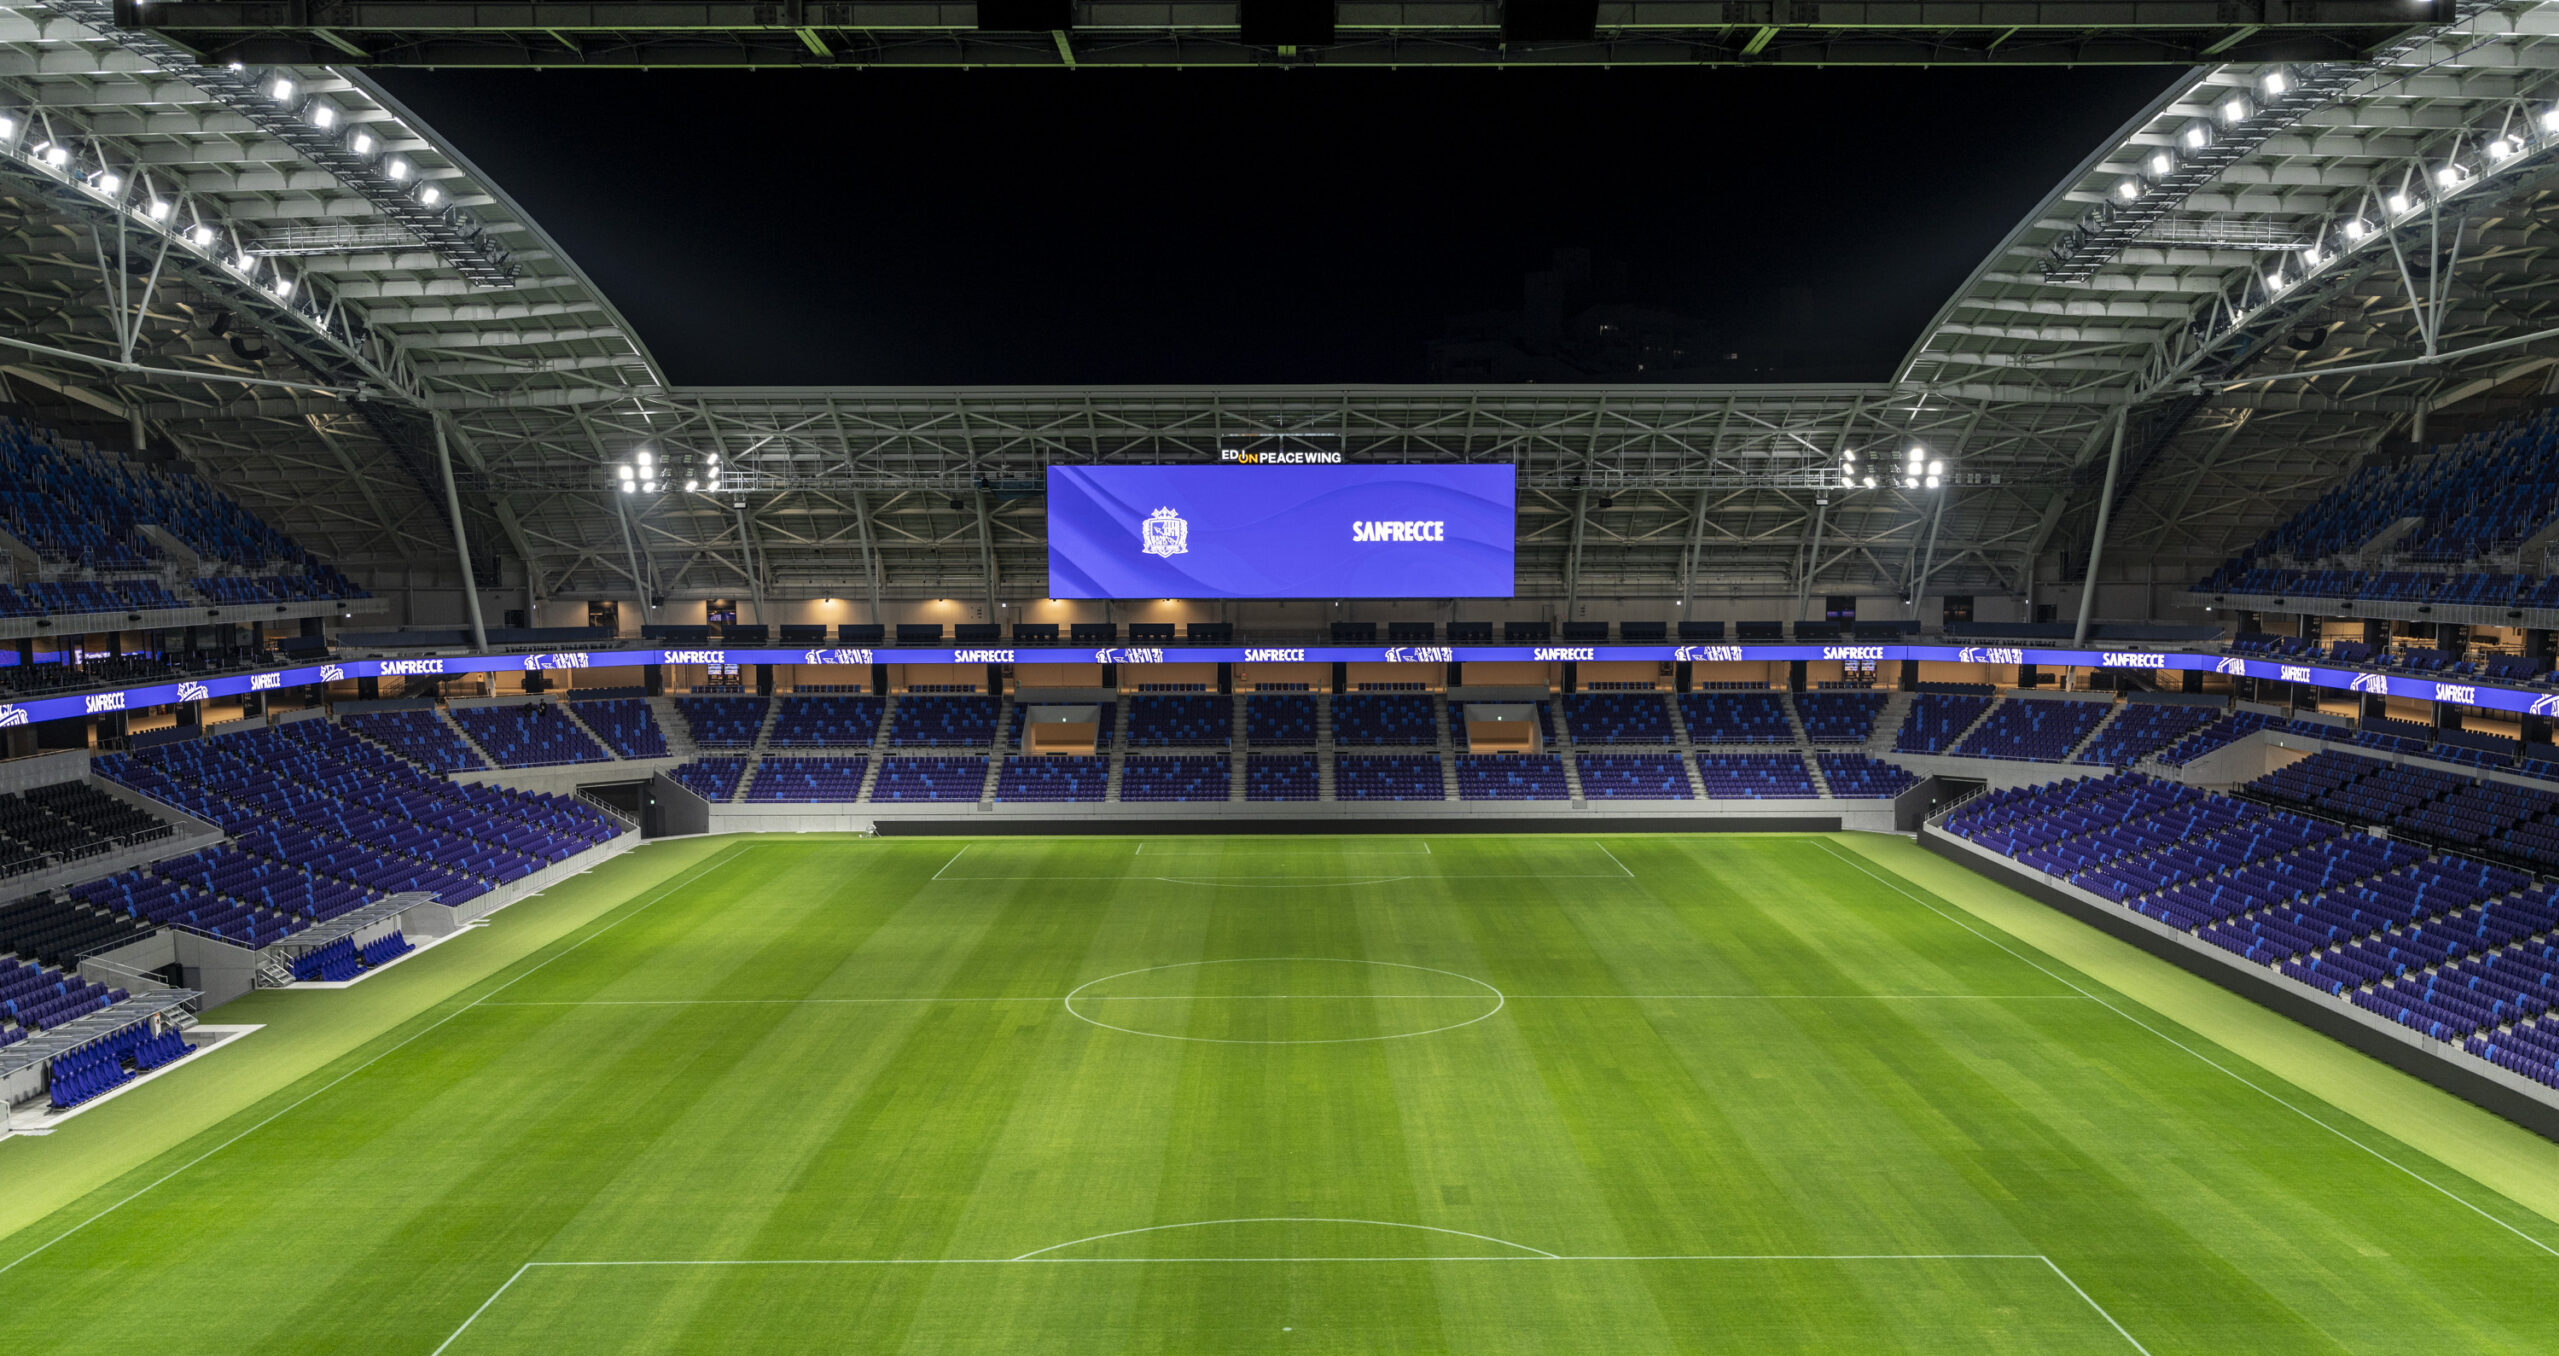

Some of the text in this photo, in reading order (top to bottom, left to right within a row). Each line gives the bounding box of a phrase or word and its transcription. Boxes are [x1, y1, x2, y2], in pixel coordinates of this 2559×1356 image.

[1221, 449, 1342, 463] EDION PEACE WING
[1352, 520, 1444, 542] SANFRECCE
[664, 650, 725, 664] SANFRECCE
[954, 649, 1015, 663] SANFRECCE
[1244, 648, 1305, 662] SANFRECCE
[1533, 647, 1594, 661] SANFRECCE
[1823, 646, 1884, 660] SANFRECCE
[2102, 652, 2165, 668] SANFRECCE
[380, 659, 443, 675] SANFRECCE
[2281, 664, 2311, 683] SANFRECCE
[251, 673, 280, 691] SANFRECCE
[2435, 683, 2476, 705] SANFRECCE
[85, 692, 125, 713] SANFRECCE
